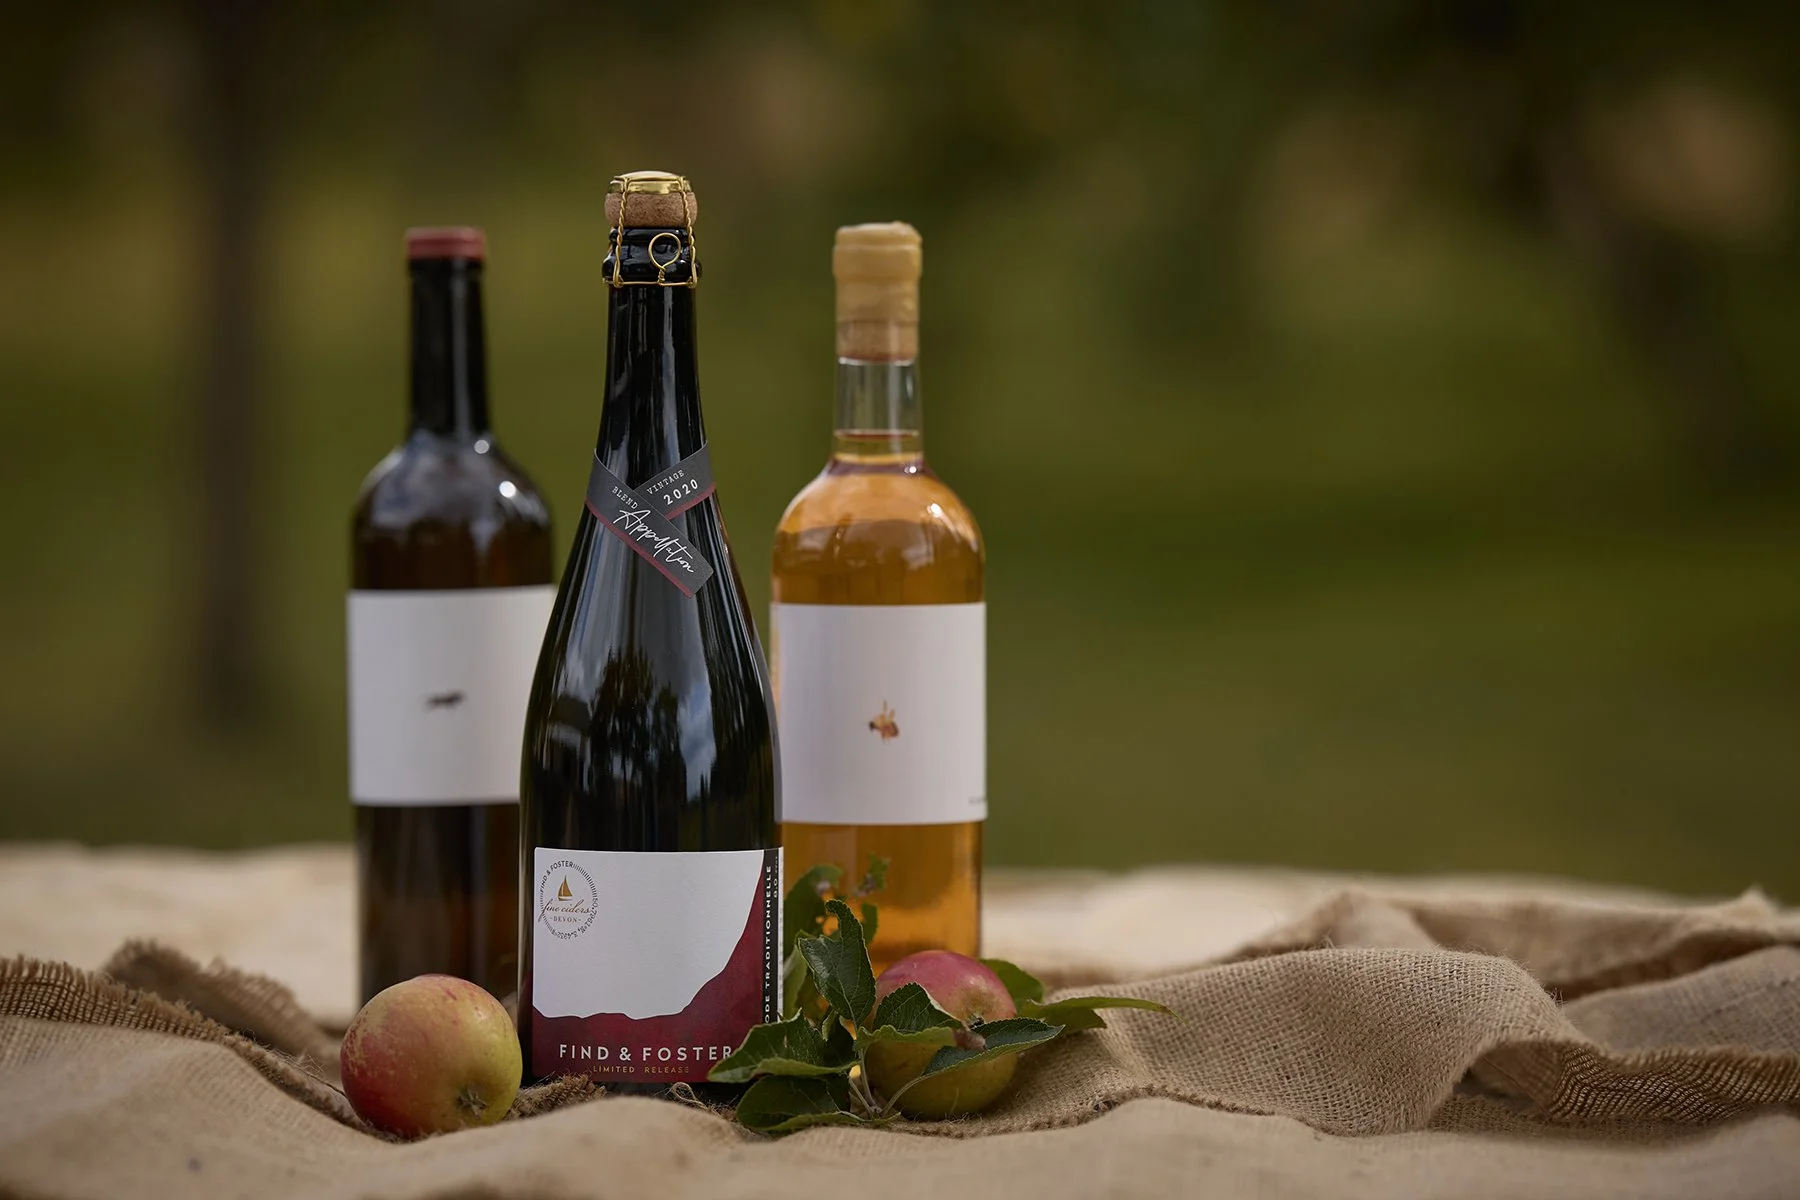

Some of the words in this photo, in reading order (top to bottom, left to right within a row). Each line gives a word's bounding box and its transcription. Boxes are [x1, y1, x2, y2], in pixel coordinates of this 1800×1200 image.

[646, 469, 685, 495] VINTAGE
[663, 478, 699, 505] 2020
[611, 486, 638, 509] BLEND
[540, 875, 548, 894] FIND
[550, 860, 573, 871] FOSTER
[538, 898, 560, 922] fine
[560, 899, 592, 914] ciders
[764, 866, 772, 989] TRADITIONNELLE
[559, 1044, 609, 1061] FIND
[619, 1048, 632, 1061] &
[642, 1045, 733, 1062] FOSTER
[593, 1065, 635, 1073] LIMITED
[644, 1066, 690, 1074] RELEASE
